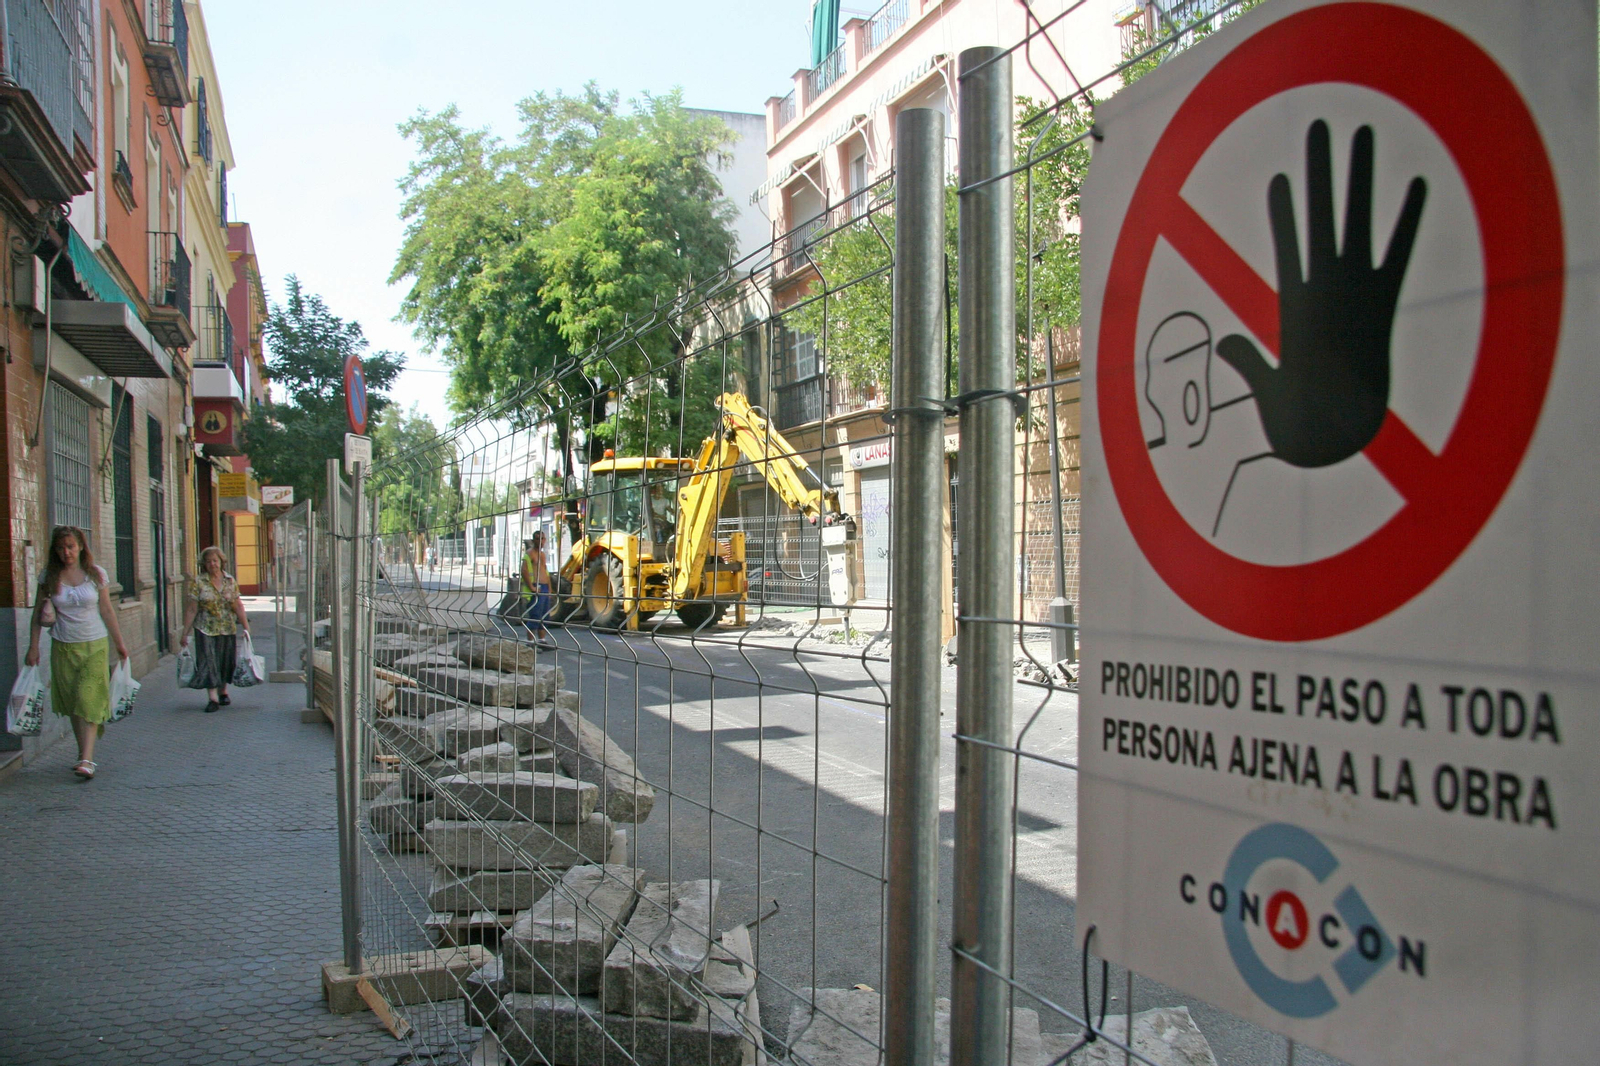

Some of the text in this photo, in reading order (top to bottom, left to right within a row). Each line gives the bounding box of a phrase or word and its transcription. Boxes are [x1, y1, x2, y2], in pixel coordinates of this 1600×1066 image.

[1101, 660, 1561, 745] PROHIBIDO EL PASO A TODA
[1102, 717, 1558, 831] PERSONA AJENA A LA OBRA
[1179, 872, 1427, 979] CONACON
